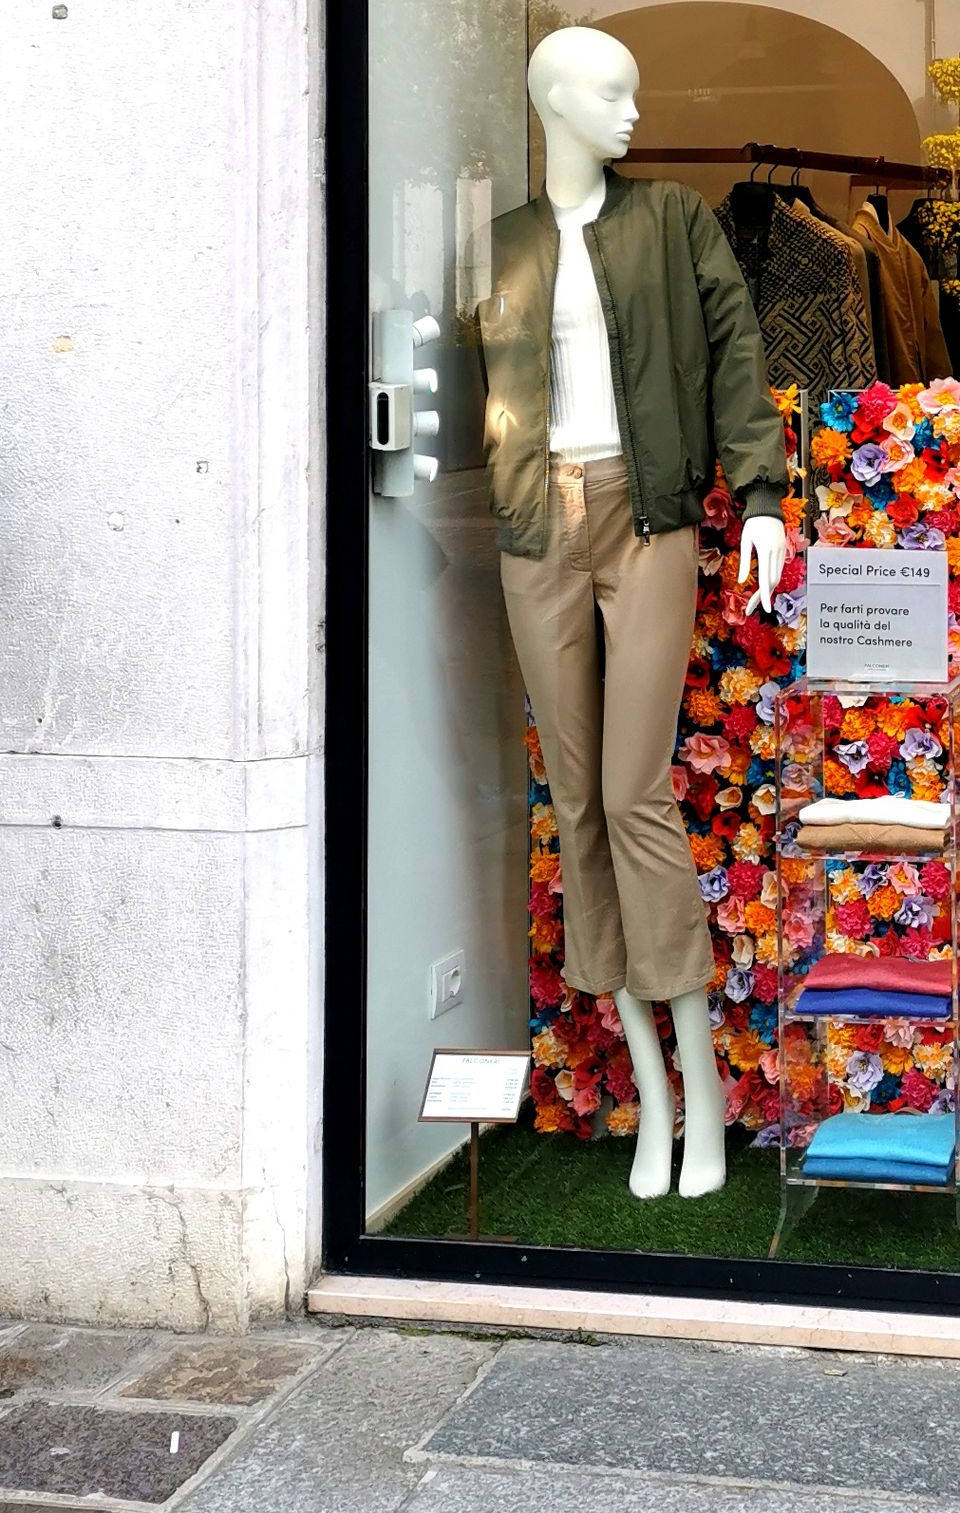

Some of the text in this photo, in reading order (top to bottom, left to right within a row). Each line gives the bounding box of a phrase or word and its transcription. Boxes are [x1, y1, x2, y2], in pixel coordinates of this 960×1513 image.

[818, 563, 930, 578] Special Price €149
[820, 603, 910, 617] Per farti provare
[820, 619, 891, 631] la qualità del
[820, 635, 913, 647] nostro Cashmere
